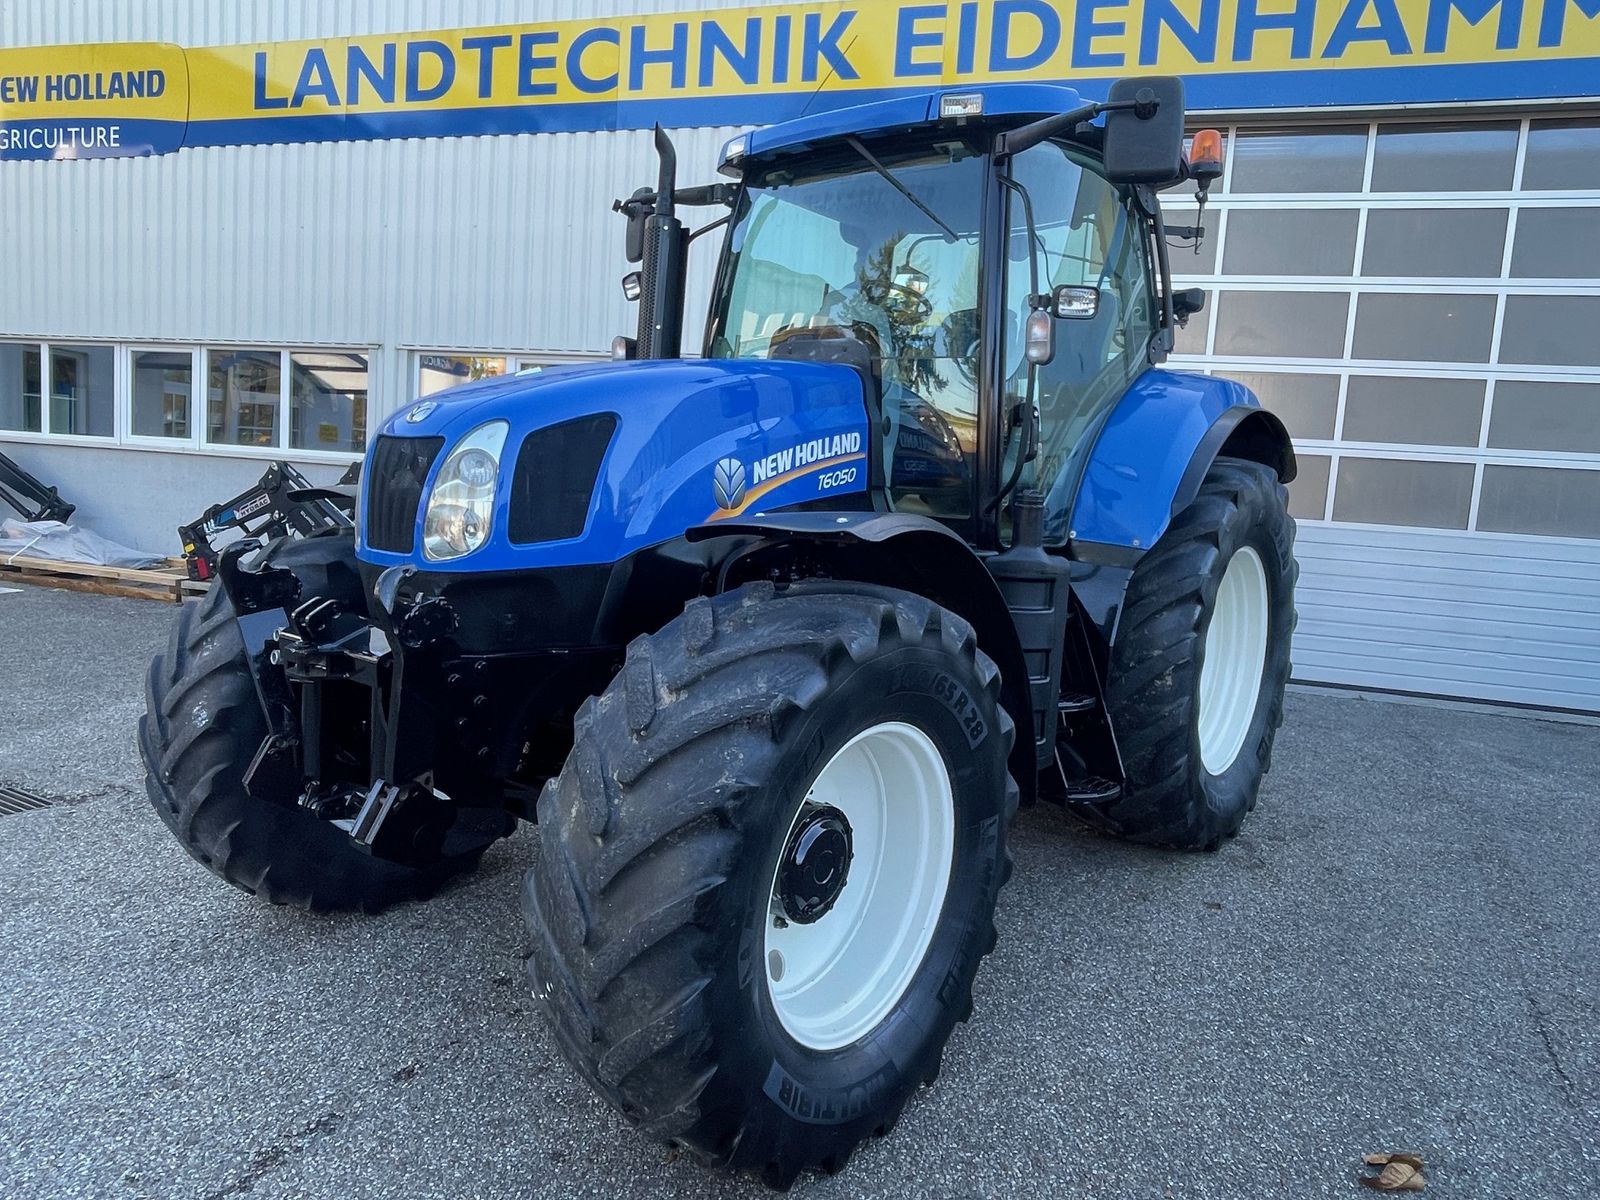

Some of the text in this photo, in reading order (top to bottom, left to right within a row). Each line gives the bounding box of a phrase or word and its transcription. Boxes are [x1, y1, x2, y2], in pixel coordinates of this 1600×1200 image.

[253, 10, 861, 110] LANDTECHNIK
[0, 69, 165, 103] EW HOLLAND
[0, 126, 120, 149] GRICULTURE
[753, 448, 793, 484] NEW
[795, 432, 860, 467] HOLLAND
[818, 467, 857, 490] T6050
